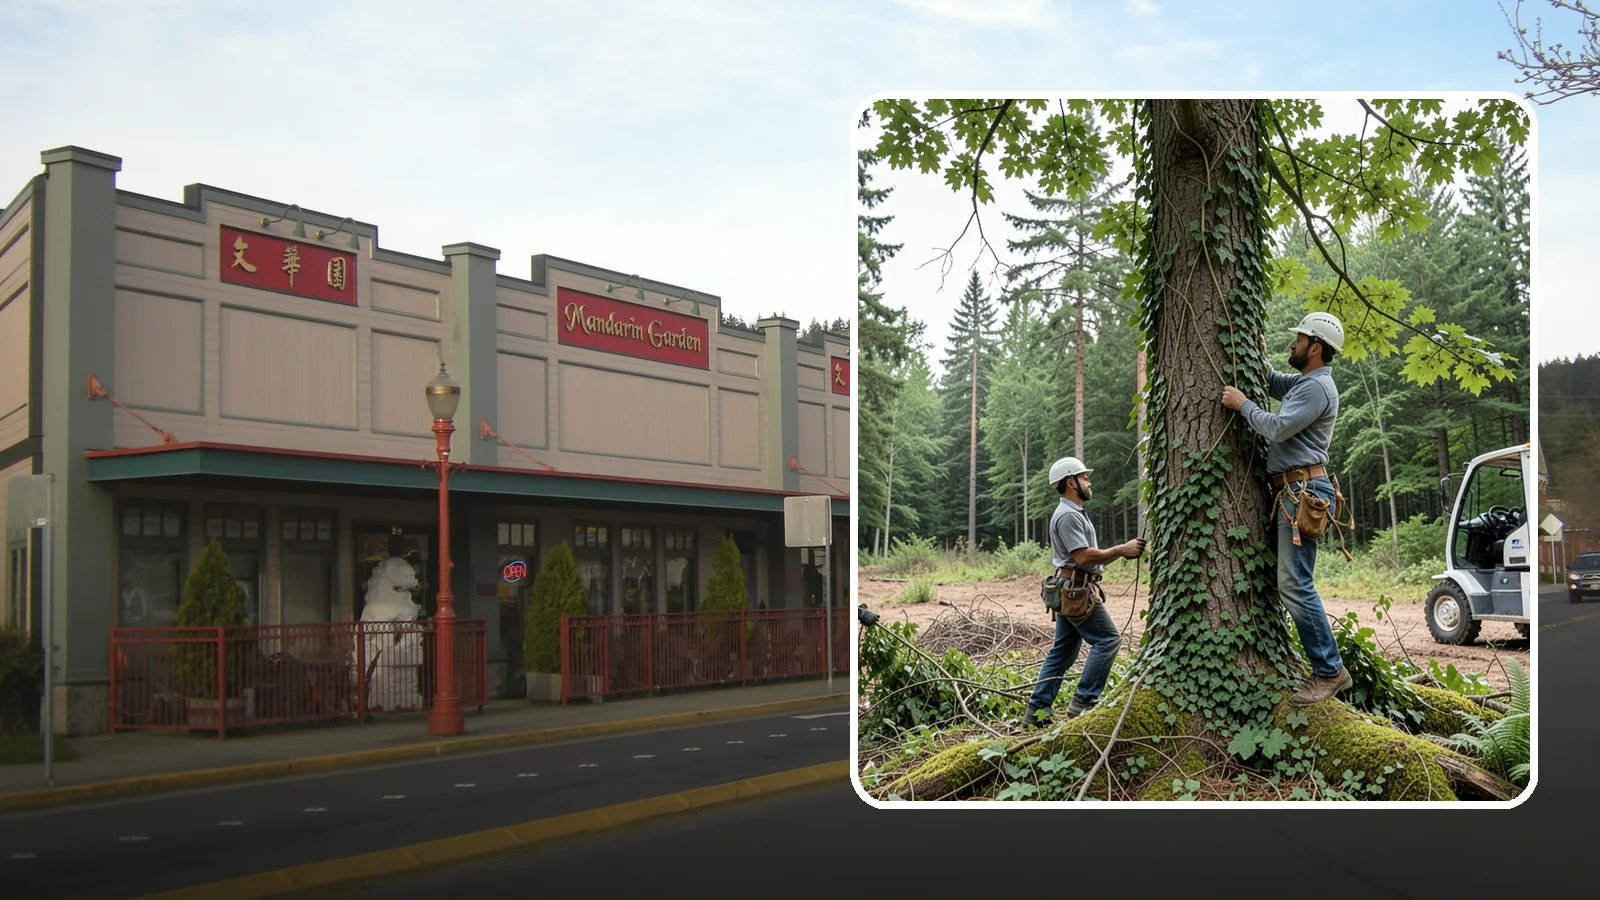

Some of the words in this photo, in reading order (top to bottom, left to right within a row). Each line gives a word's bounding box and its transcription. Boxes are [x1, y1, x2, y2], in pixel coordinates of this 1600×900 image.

[230, 235, 346, 291] 文華園
[564, 302, 644, 341] Mandarin
[647, 320, 702, 352] Garden
[503, 565, 527, 578] OPEN
